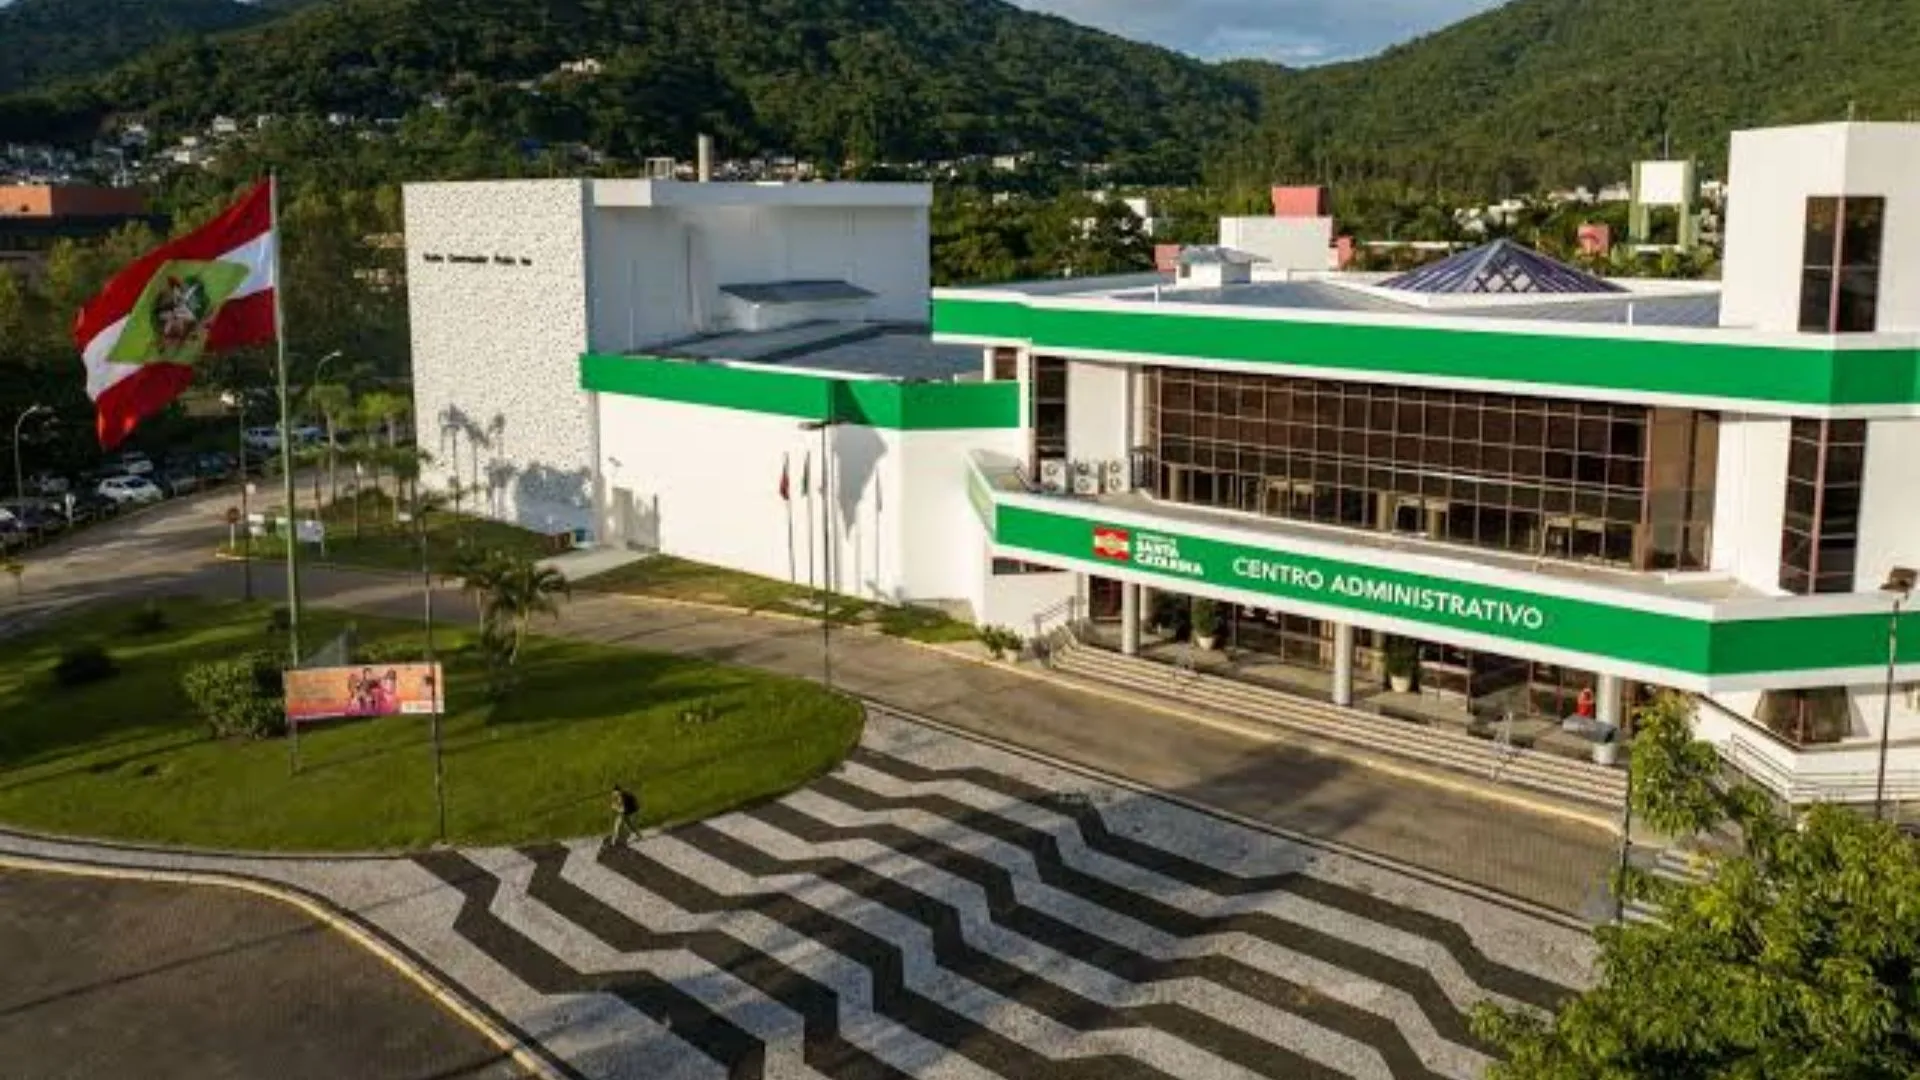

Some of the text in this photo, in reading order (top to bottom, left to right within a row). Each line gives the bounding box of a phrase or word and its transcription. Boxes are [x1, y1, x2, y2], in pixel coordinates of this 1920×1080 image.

[1136, 538, 1179, 558] SANTA
[1232, 556, 1543, 629] CENTRO ADMINISTRATIVO
